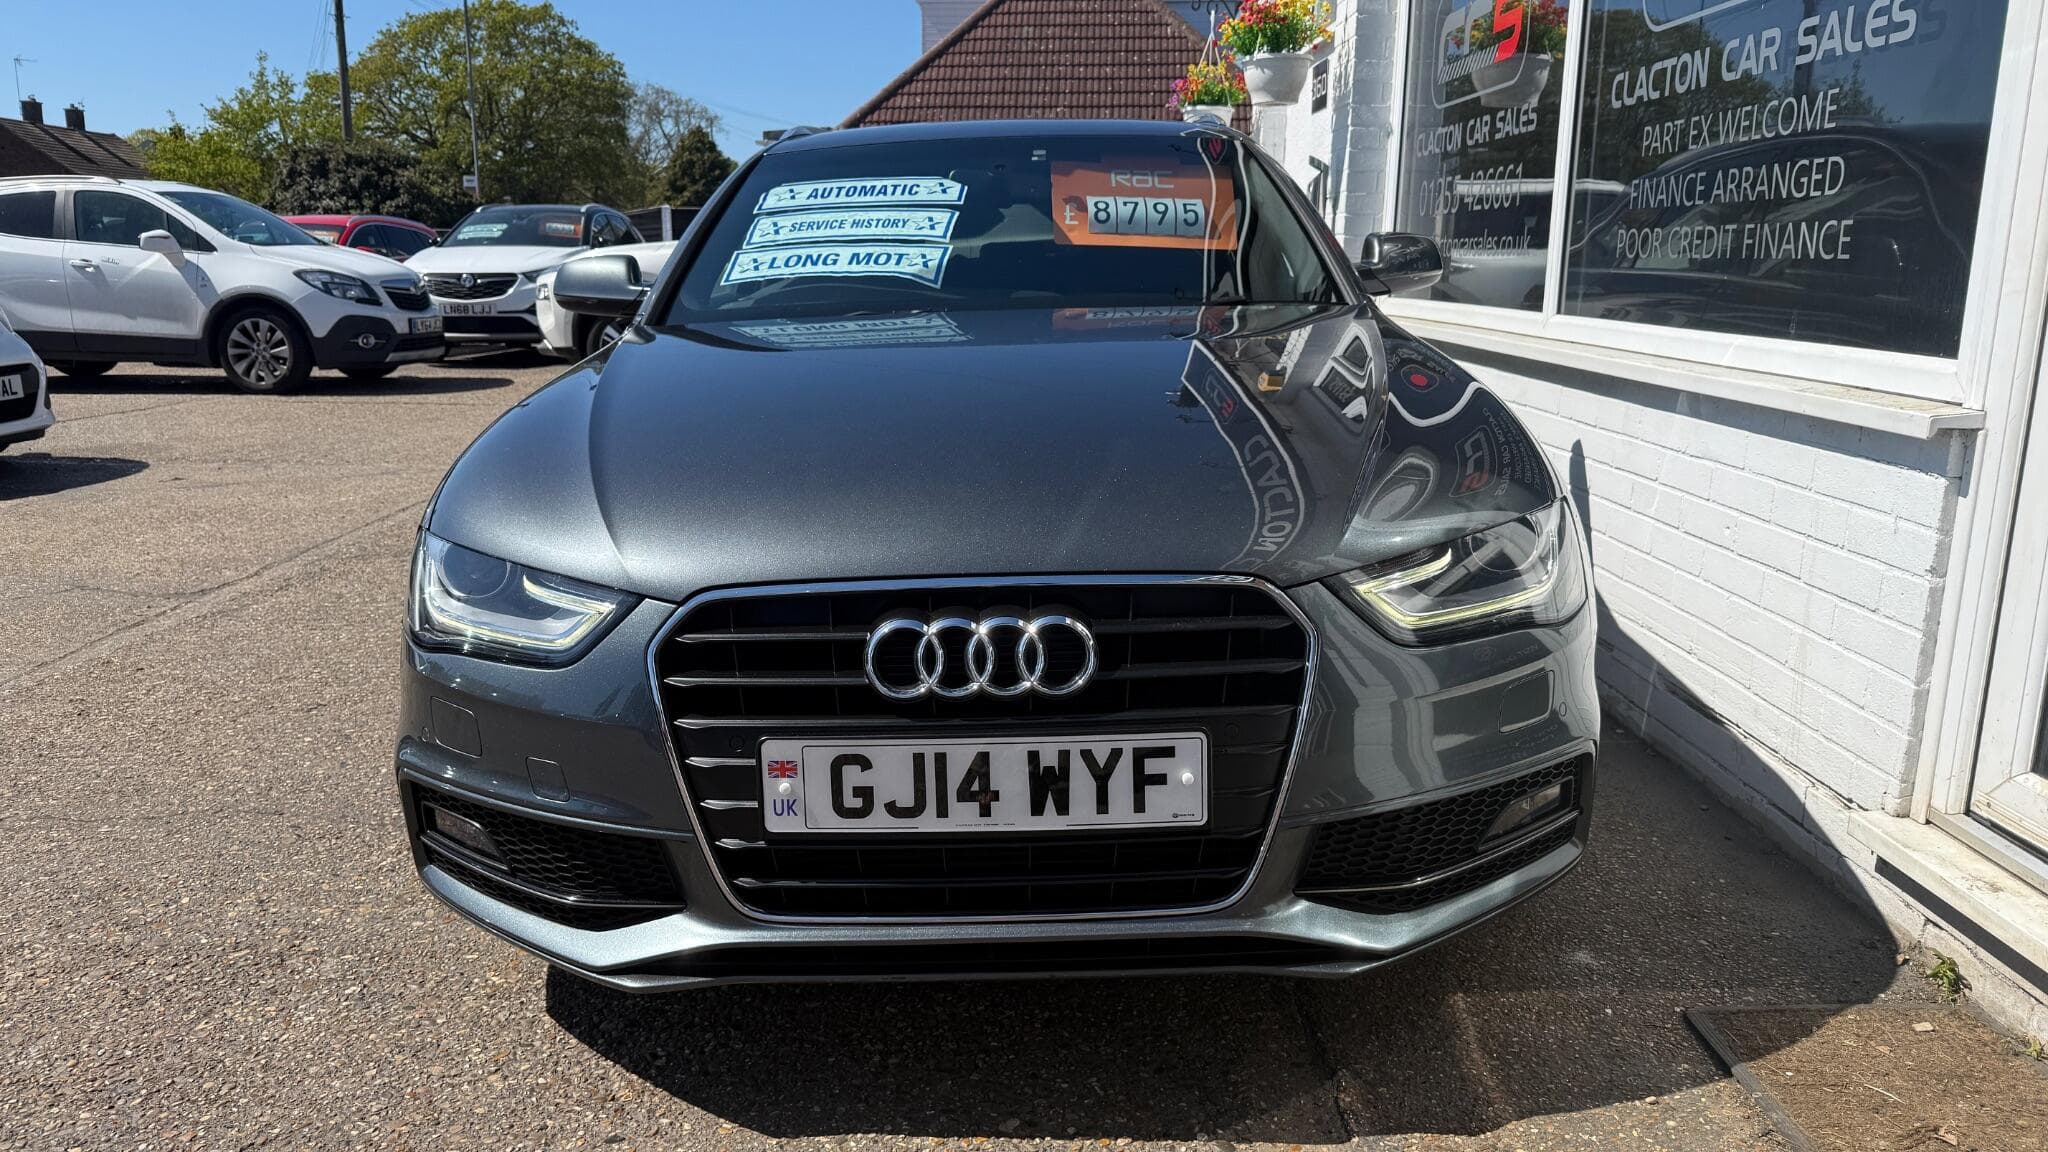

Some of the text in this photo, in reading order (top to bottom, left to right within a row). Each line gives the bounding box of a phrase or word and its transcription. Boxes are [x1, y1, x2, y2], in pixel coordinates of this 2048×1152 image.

[1611, 0, 1918, 109] CLACTON CAR SALES
[1416, 103, 1538, 157] CLACTON CAR SALES
[1641, 87, 1841, 158] PART EX WELCOME
[806, 183, 921, 201] AUTOMATIC
[1419, 161, 1524, 217] 01255 426661
[1629, 155, 1846, 209] FINANCE ARRANGED
[788, 217, 910, 233] SERVICE HISTORY
[1093, 200, 1199, 227] 8795
[767, 252, 909, 269] LONG MOT
[1616, 219, 1854, 259] POOR CREDIT FINANCE
[830, 746, 1176, 819] GJ14 WYF
[773, 799, 798, 817] UK
